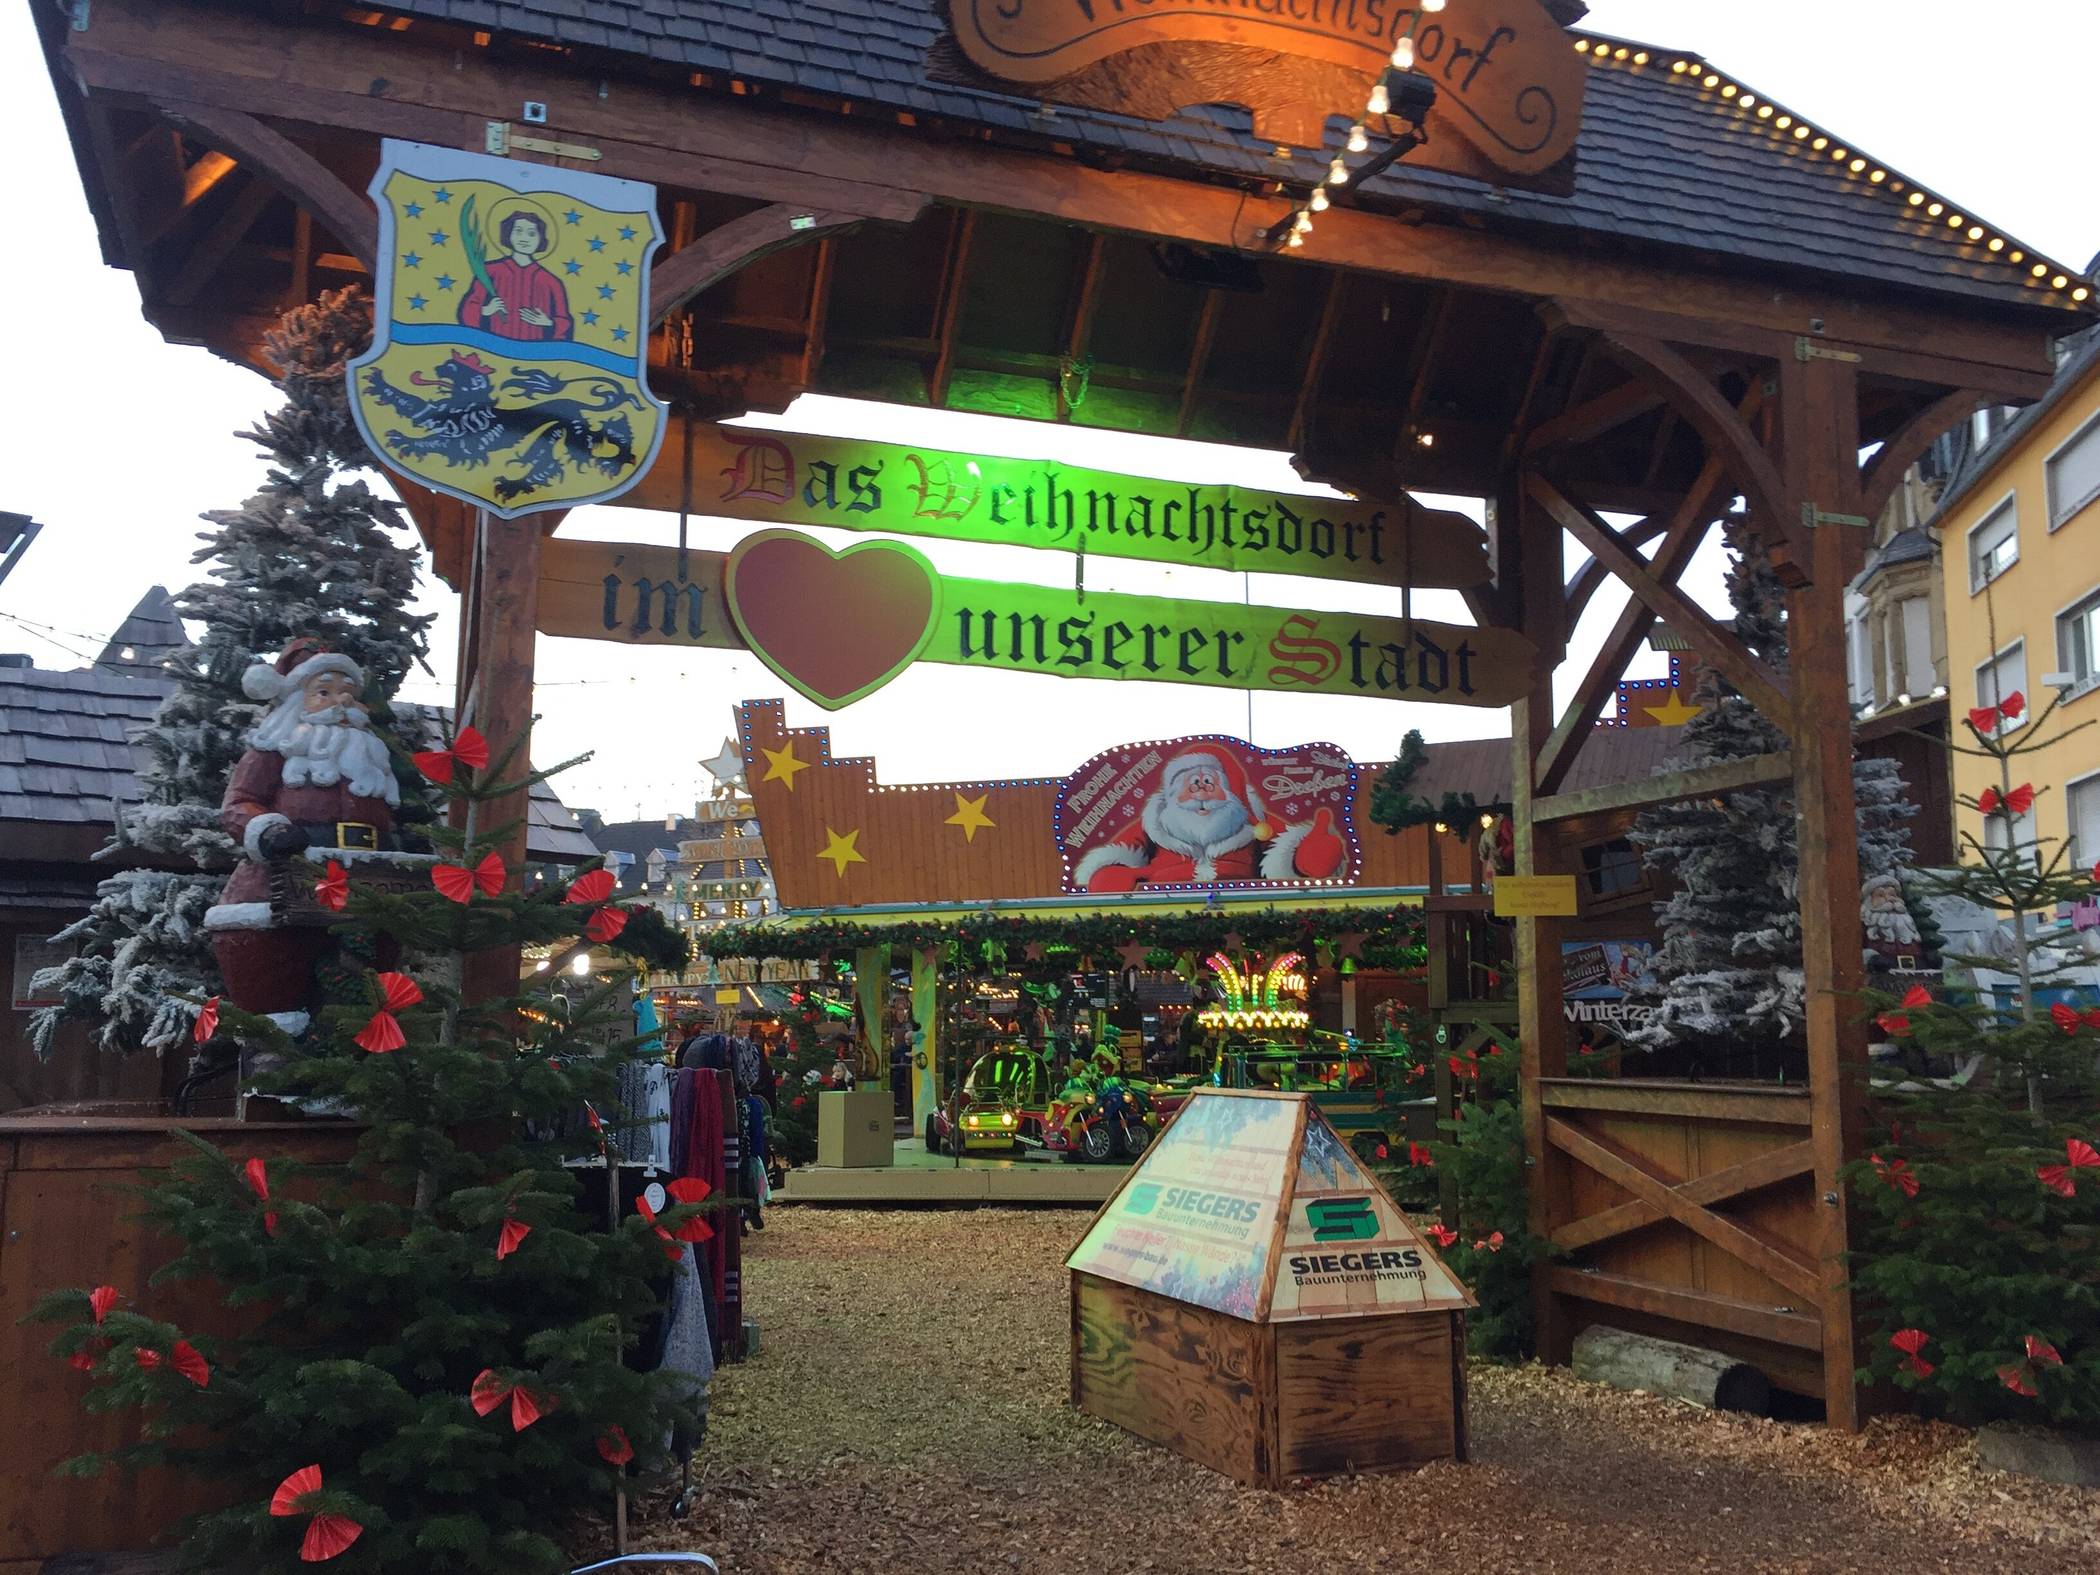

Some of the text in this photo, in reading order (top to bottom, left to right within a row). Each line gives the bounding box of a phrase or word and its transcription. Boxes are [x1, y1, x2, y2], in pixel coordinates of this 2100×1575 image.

[719, 428, 1388, 567] Das Weihnachtsdorf
[602, 555, 1479, 698] im unserer Stadt
[1064, 750, 1163, 849] WEIHNACHTEN
[1066, 762, 1119, 814] FROHE
[660, 972, 705, 986] HAPY
[1162, 1187, 1261, 1223] SIEGERS
[1155, 1207, 1250, 1240] Bauunternehmung
[1289, 1251, 1423, 1275] SIEGERS
[1294, 1269, 1427, 1287] Bauunternehmung
